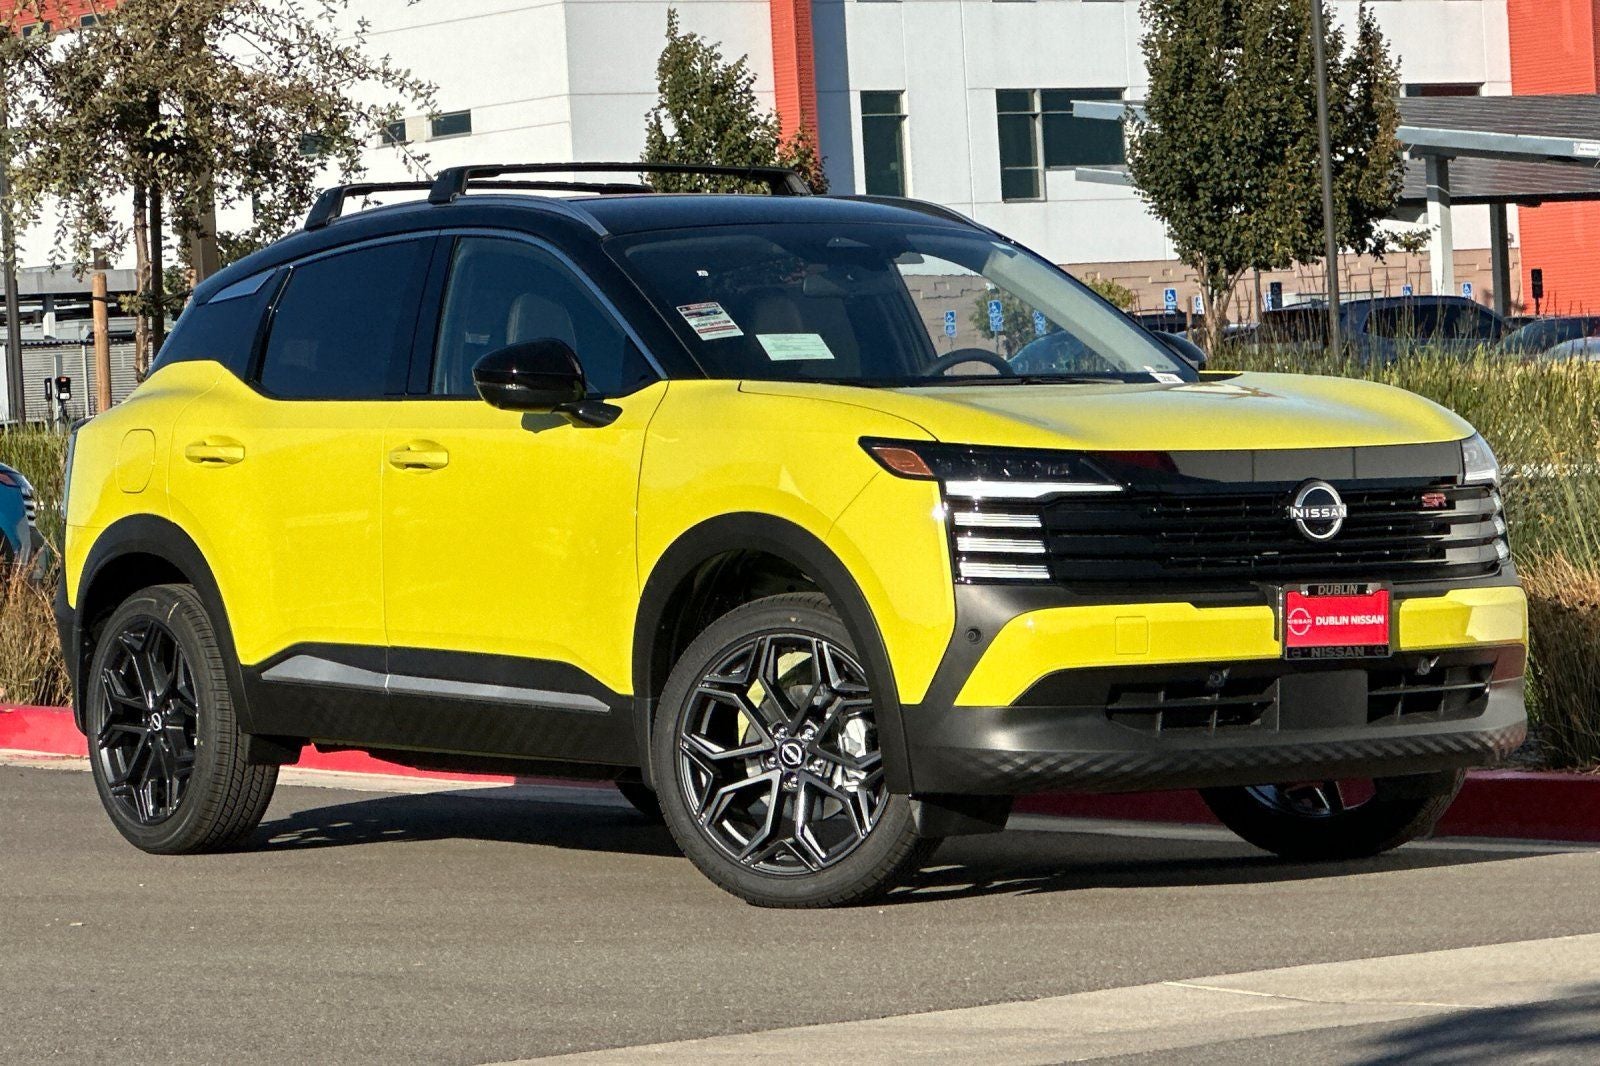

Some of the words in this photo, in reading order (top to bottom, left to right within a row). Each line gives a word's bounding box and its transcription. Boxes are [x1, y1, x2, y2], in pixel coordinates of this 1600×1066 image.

[1293, 506, 1347, 518] NISSAN
[1318, 584, 1358, 595] DUBLIN
[1315, 615, 1349, 626] DUBLIN
[1351, 614, 1384, 625] NISSAN
[1311, 646, 1365, 658] NISSAN
